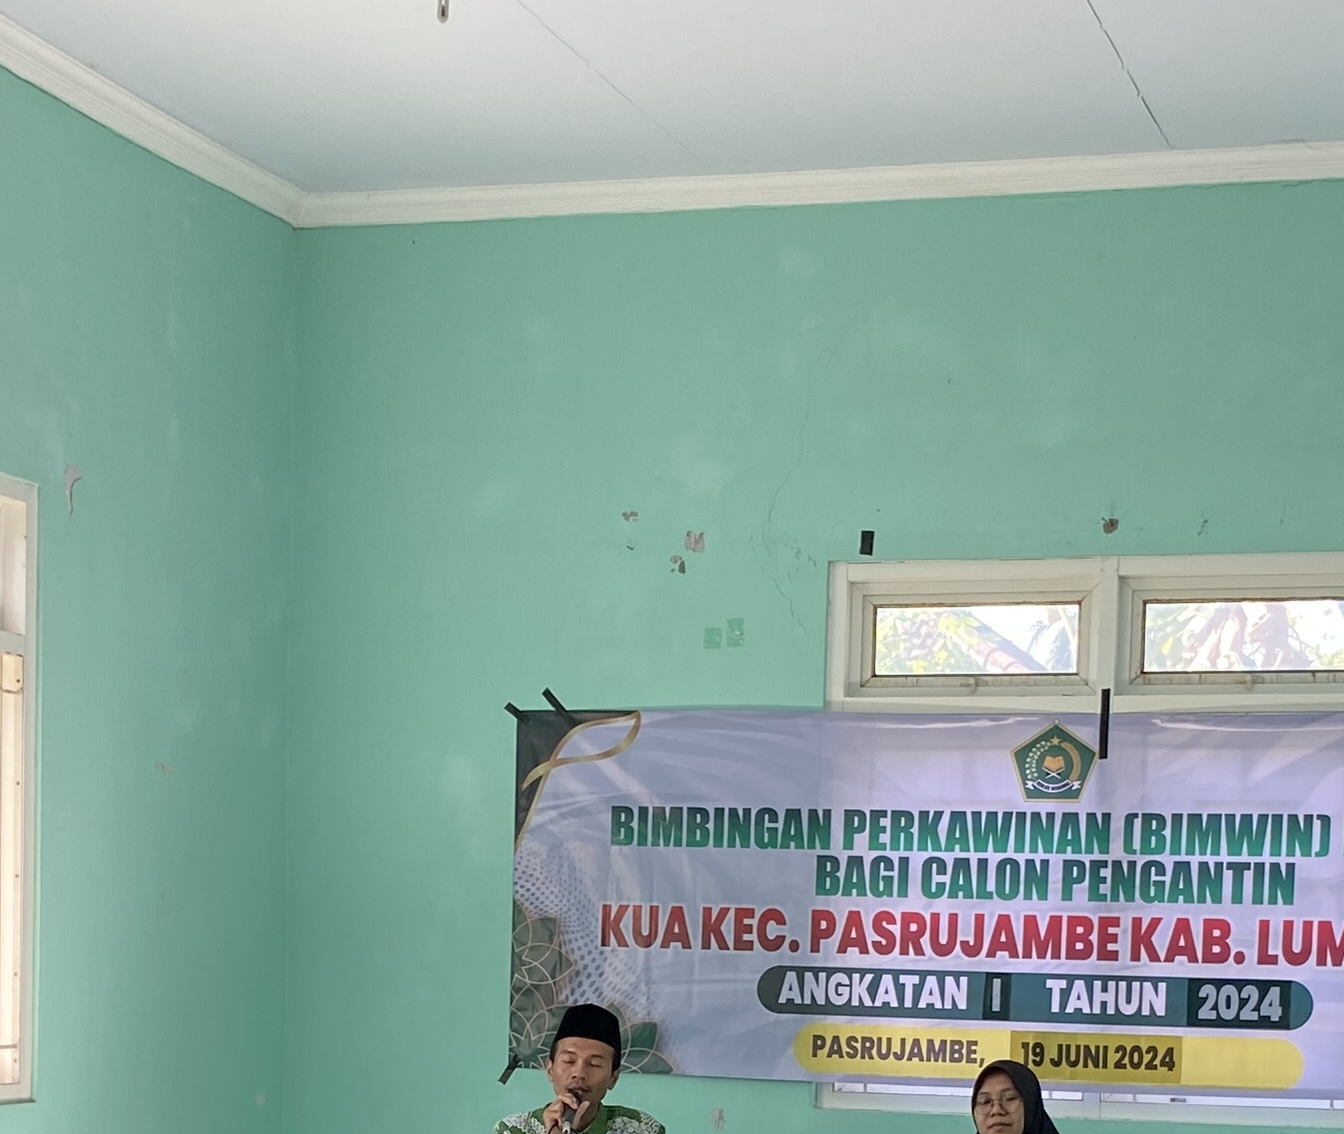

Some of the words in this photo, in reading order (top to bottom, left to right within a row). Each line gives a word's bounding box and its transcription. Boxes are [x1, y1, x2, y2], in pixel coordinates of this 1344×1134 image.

[609, 805, 833, 852] BIMBINGAN
[842, 808, 1112, 856] PERKAWINAN
[1122, 812, 1332, 859] (BIMWIN)
[814, 854, 909, 899] BAGI
[920, 856, 1050, 902] CALON
[1061, 859, 1296, 906] PENGANTIN
[600, 903, 693, 950] KUA
[701, 906, 801, 954] KEC.
[809, 909, 1120, 963] PASRUJAMBE
[1129, 916, 1247, 967] KAB.
[777, 971, 969, 1011] ANGKATAN
[991, 977, 1003, 1013] I
[1045, 978, 1167, 1018] TAHUN
[1195, 983, 1284, 1022] 2024
[810, 1033, 986, 1069] PASRUJAMBE,
[1020, 1041, 1045, 1068] 19
[1049, 1042, 1109, 1070] JUNI
[1113, 1043, 1177, 1073] 2024
